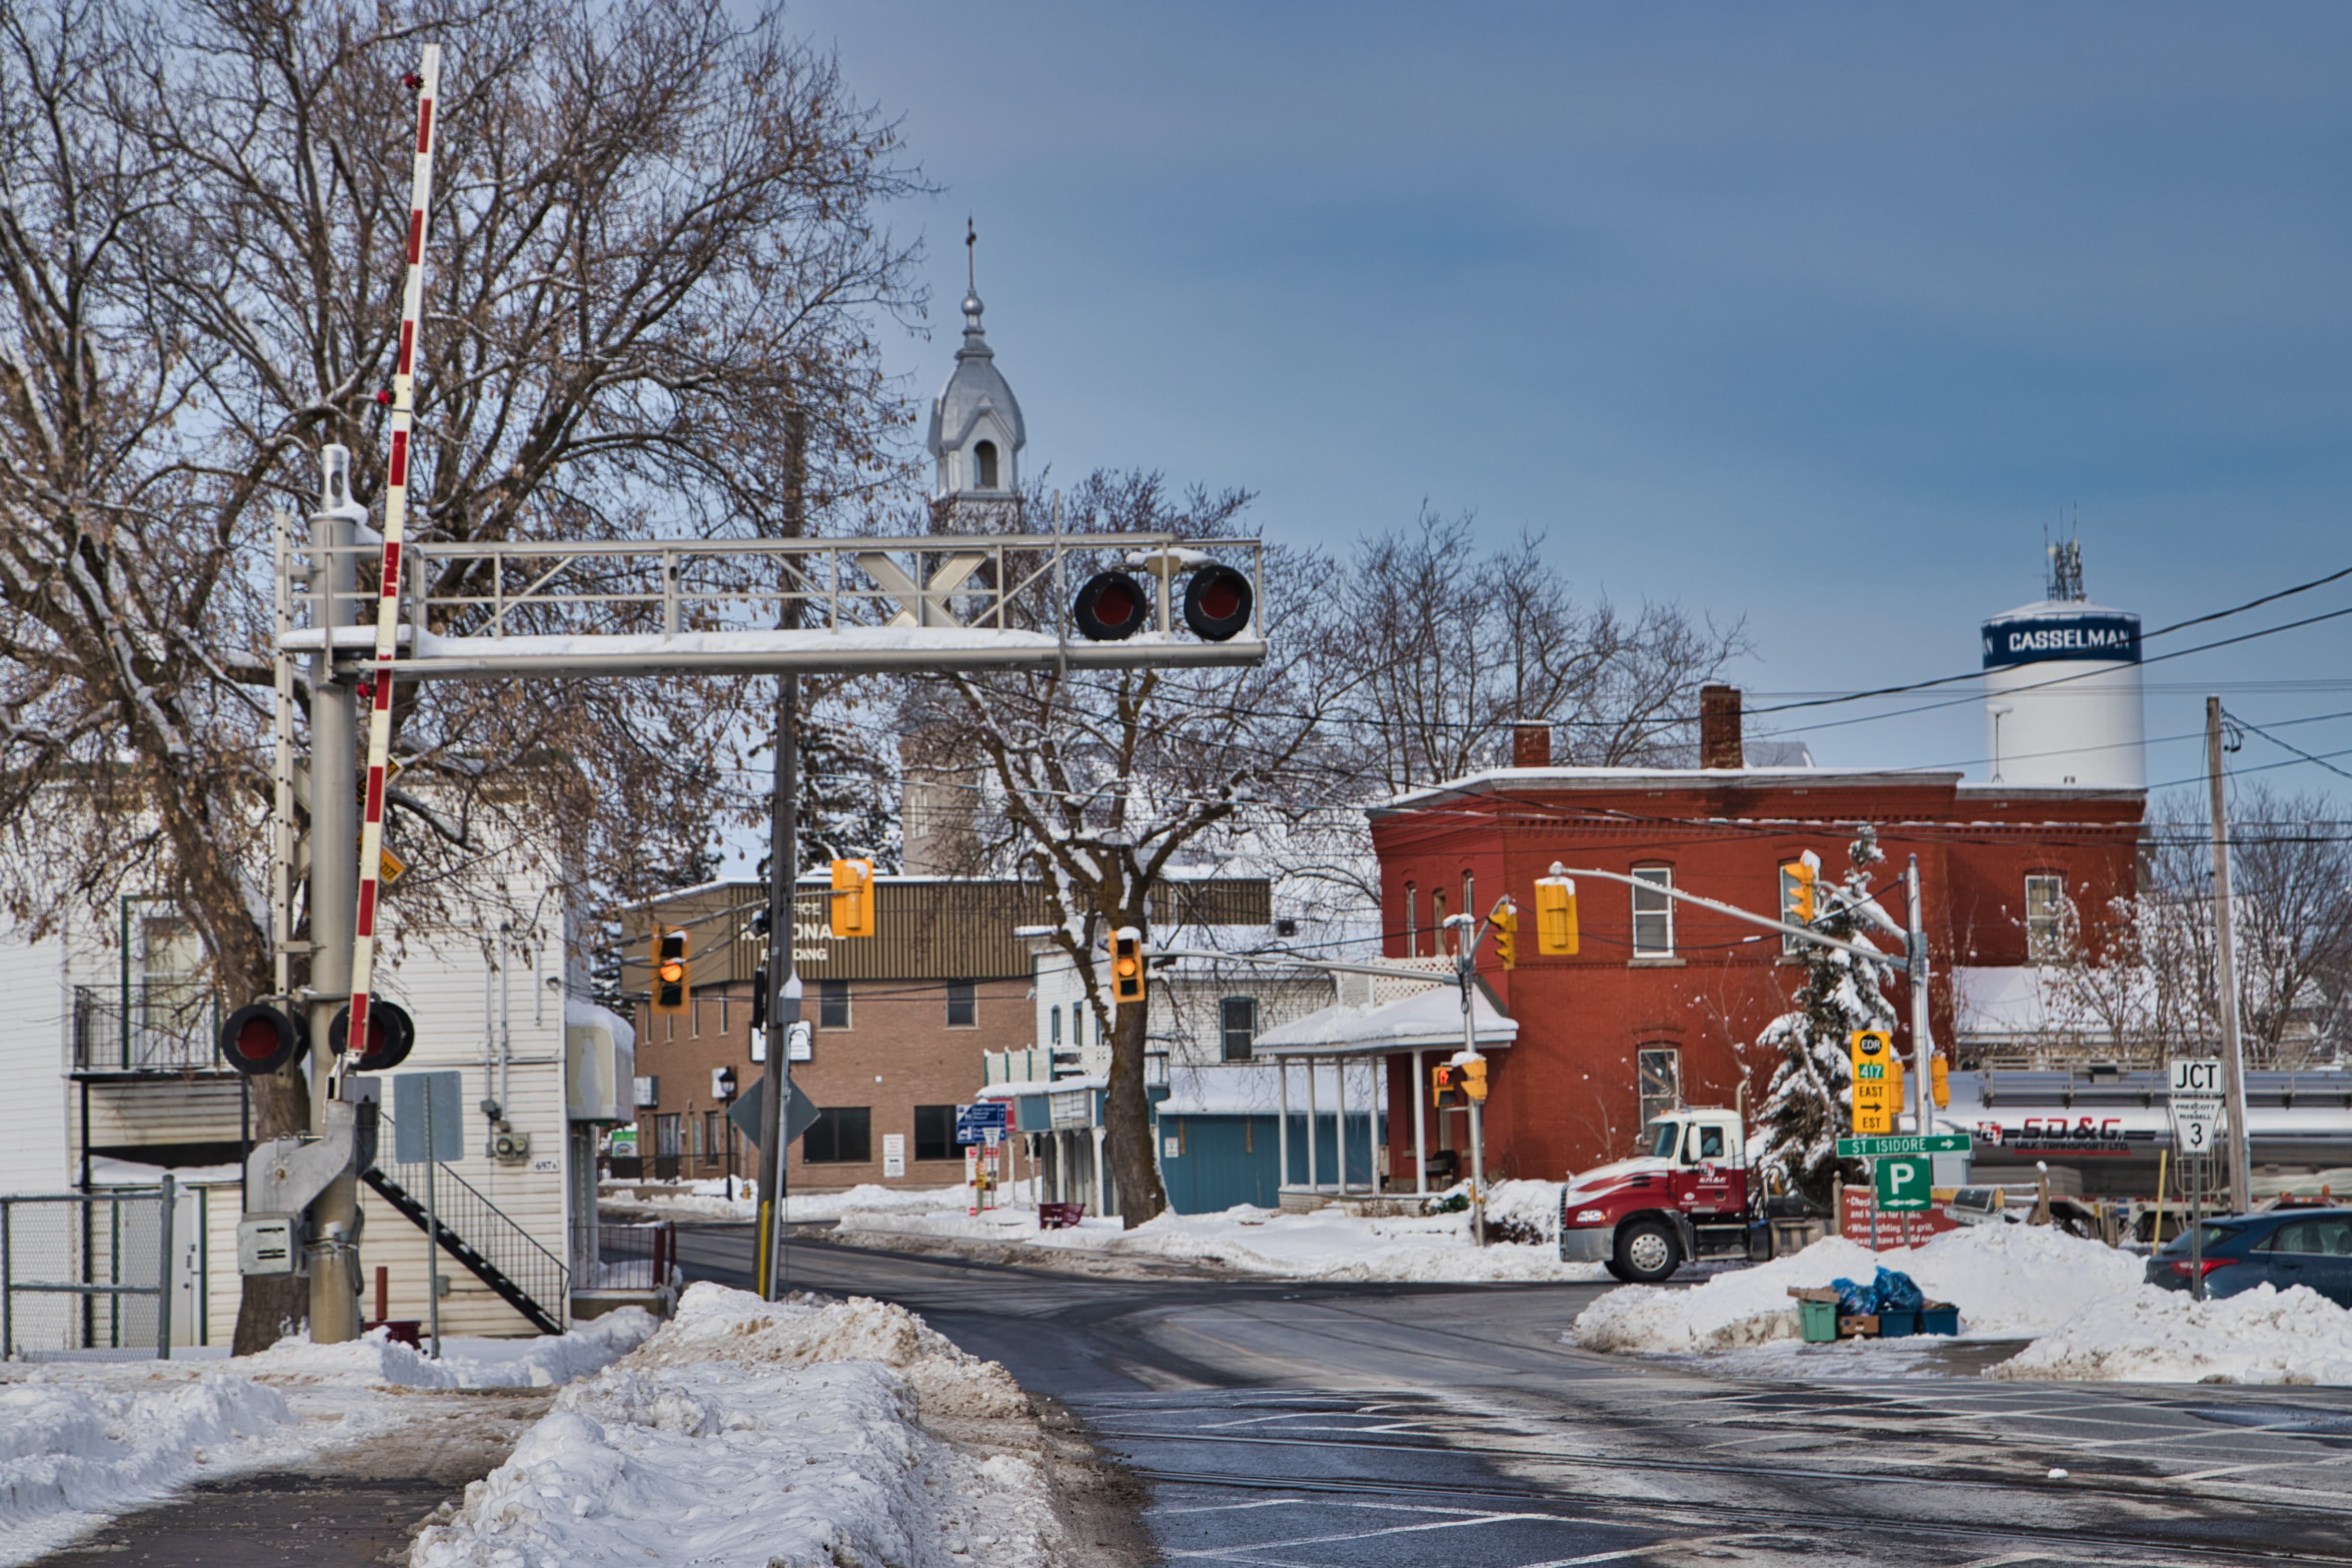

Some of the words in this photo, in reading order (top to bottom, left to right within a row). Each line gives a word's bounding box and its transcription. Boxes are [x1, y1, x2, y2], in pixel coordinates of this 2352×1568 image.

[2009, 629, 2129, 653] CASSELMAN
[1861, 1039, 1881, 1051] EDR
[1860, 1065, 1882, 1078] 417
[2175, 1063, 2217, 1089] JCT
[1859, 1086, 1883, 1097] EAST
[1863, 1117, 1881, 1128] EST
[2190, 1122, 2203, 1145] 3
[1852, 1140, 1867, 1153] ST
[1876, 1138, 1927, 1152] ISIDORE
[2014, 1142, 2038, 1150] MILK
[2042, 1142, 2105, 1150] TRANSPORT
[1890, 1163, 1915, 1195] P
[1875, 1223, 1901, 1234] ighting
